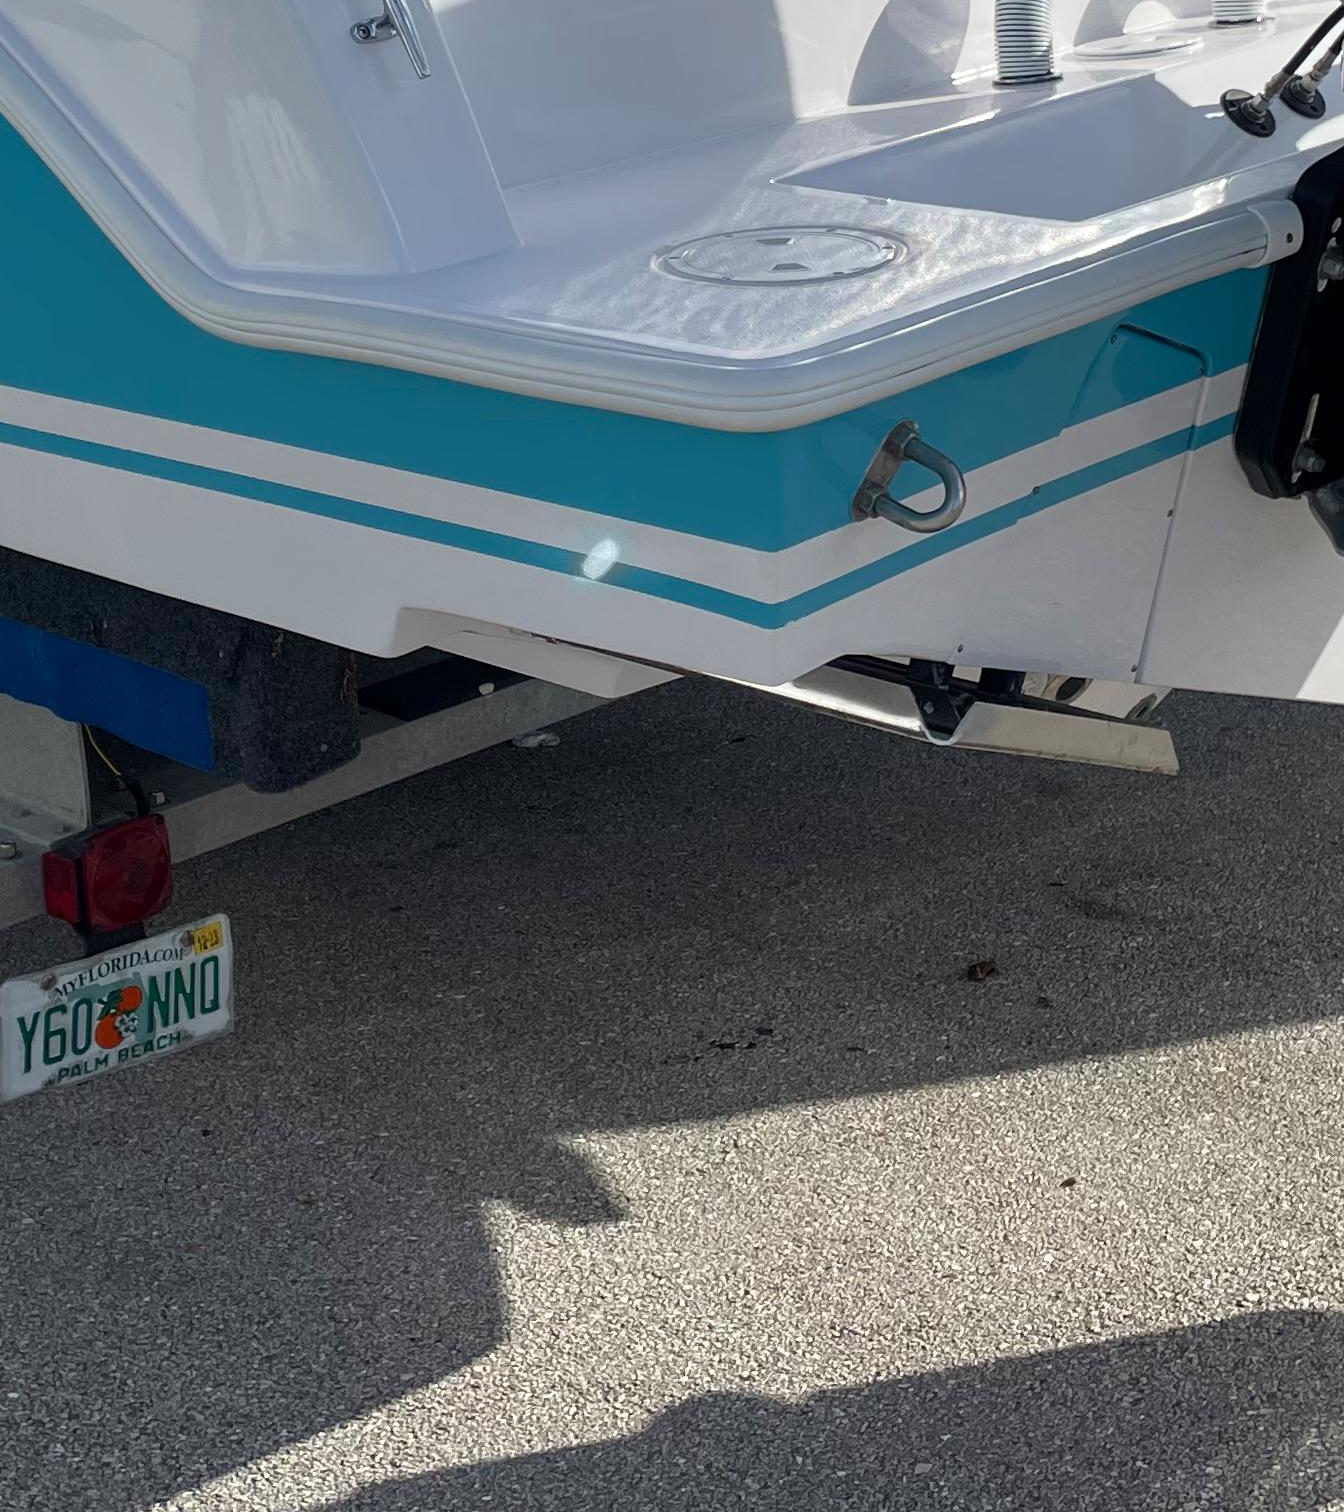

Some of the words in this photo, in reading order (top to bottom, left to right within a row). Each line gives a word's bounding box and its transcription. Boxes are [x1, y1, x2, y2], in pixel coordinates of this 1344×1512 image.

[55, 948, 184, 999] MYFLORIDA.COM
[16, 997, 94, 1074] Y60
[57, 1053, 109, 1082] PALM
[117, 1031, 181, 1063] BEACH
